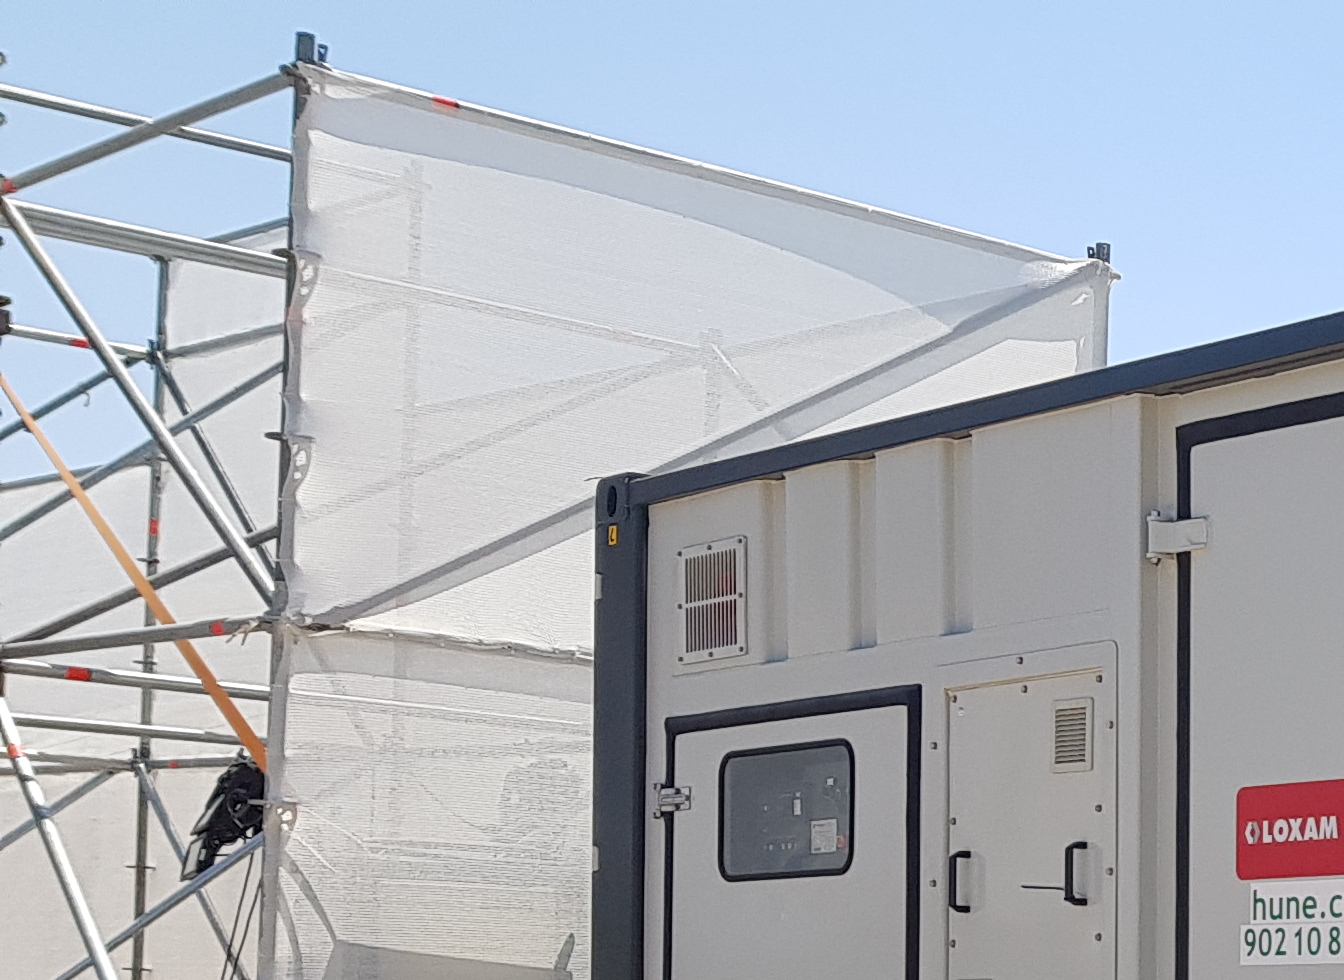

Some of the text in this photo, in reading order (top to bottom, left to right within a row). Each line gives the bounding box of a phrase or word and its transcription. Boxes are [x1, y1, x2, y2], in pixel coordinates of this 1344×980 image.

[1262, 815, 1339, 844] LOXAM
[1244, 927, 1287, 957] 902
[1294, 926, 1322, 956] 10
